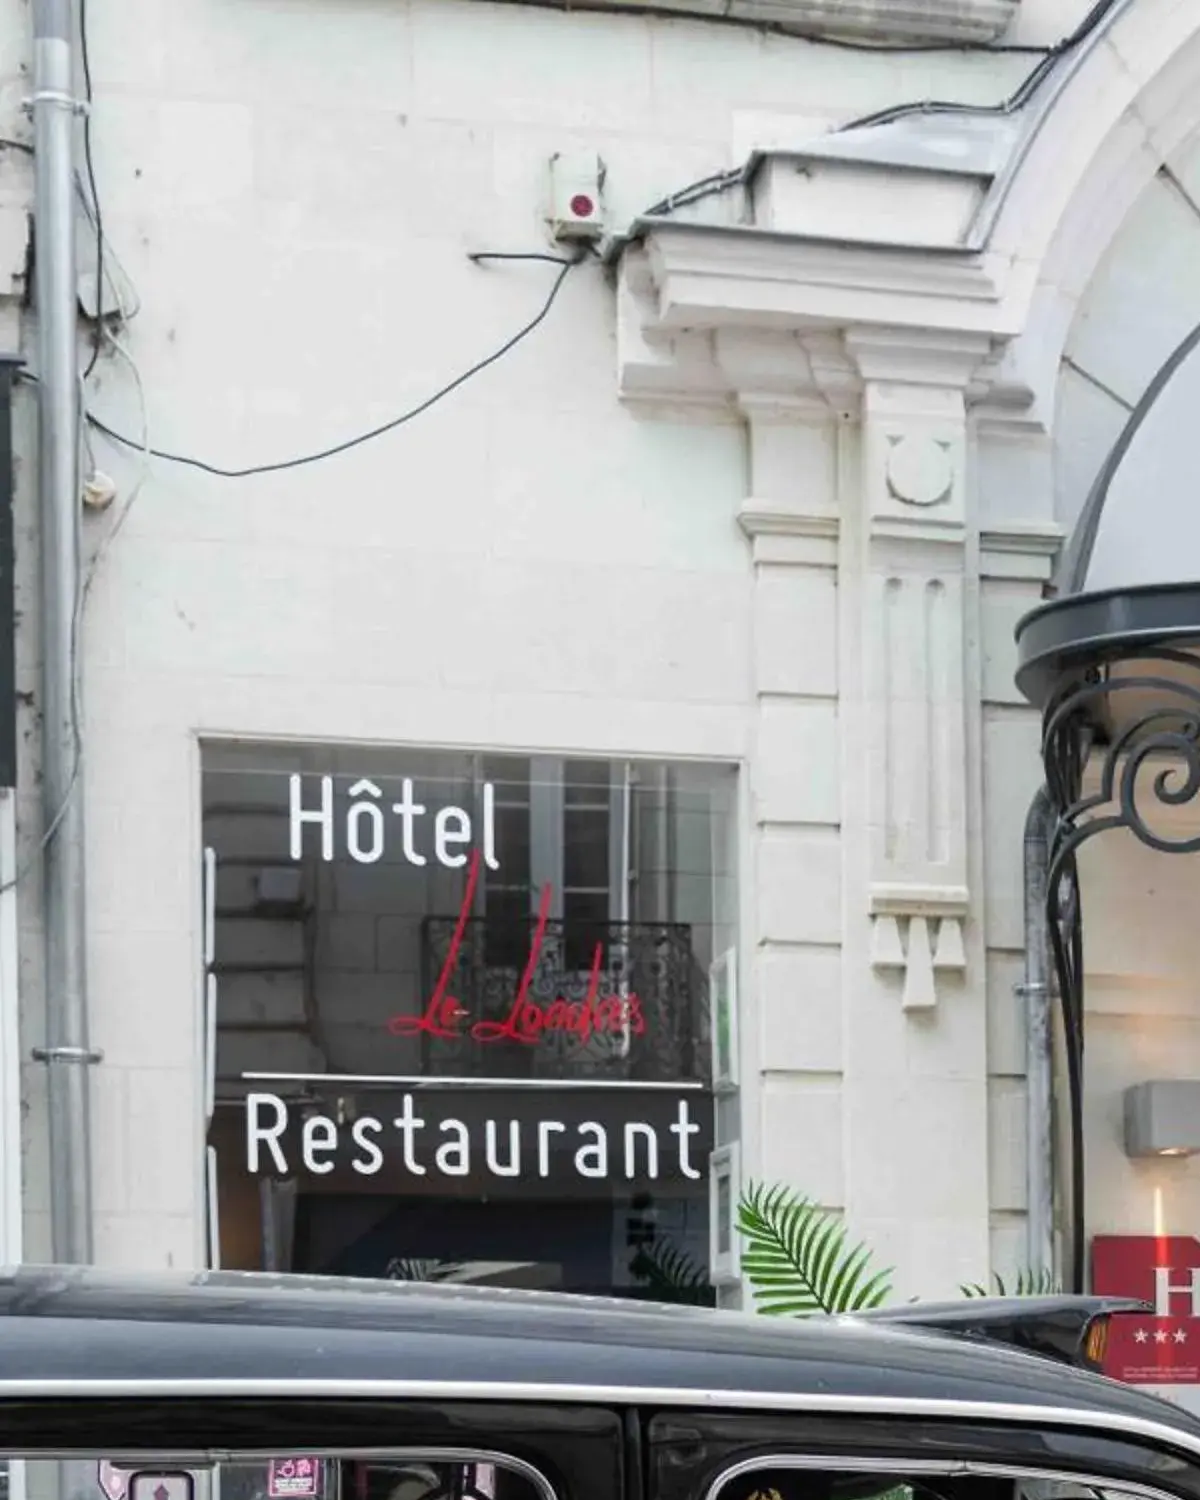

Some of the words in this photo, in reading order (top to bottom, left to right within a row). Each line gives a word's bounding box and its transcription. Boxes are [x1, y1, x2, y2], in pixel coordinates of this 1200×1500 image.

[289, 773, 500, 870] Hôtel
[387, 848, 480, 1041] Le
[470, 880, 646, 1047] Londres
[246, 1092, 701, 1180] Restaurant
